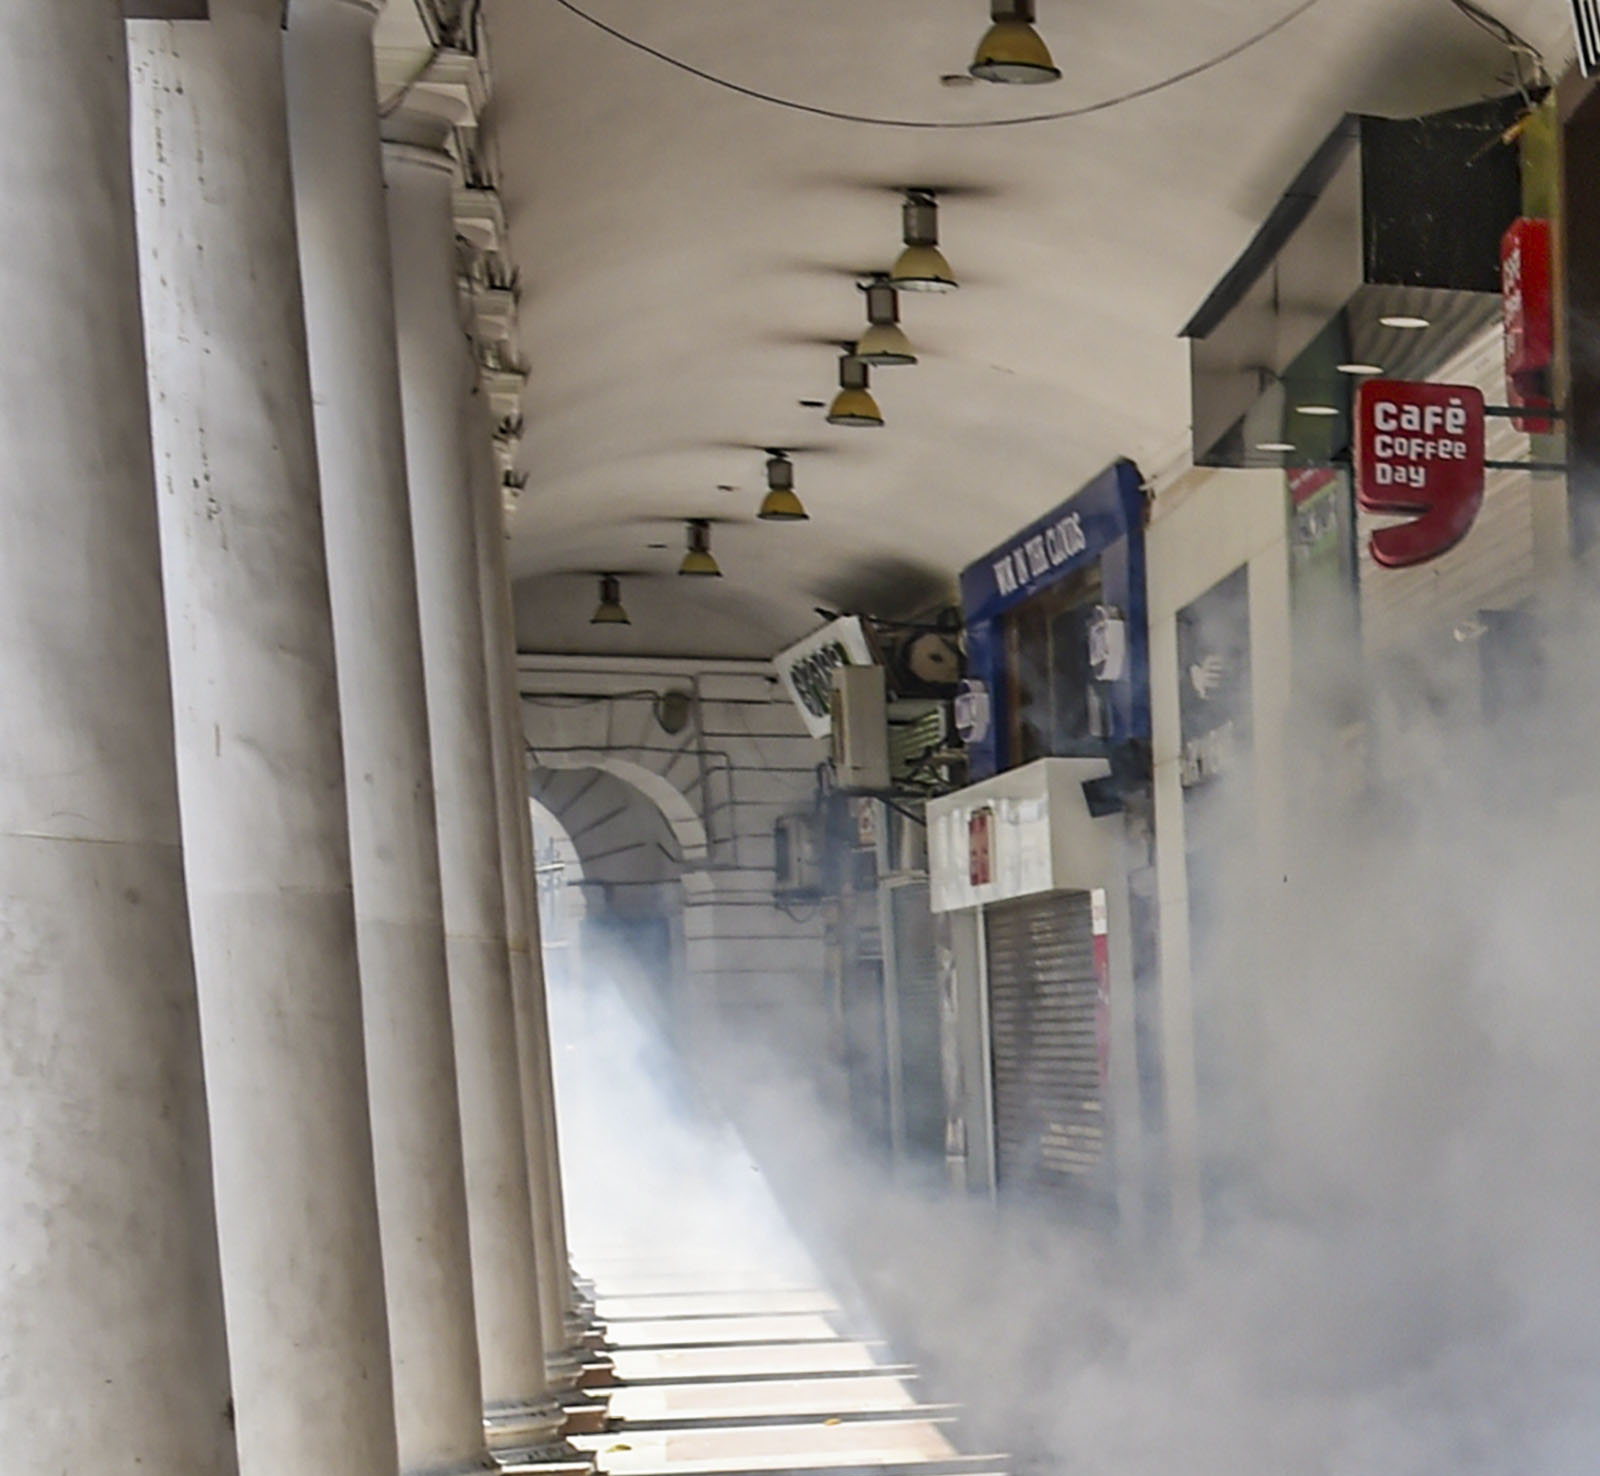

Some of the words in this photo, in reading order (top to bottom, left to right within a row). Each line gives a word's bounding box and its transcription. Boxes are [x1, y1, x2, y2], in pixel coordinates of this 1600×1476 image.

[1373, 397, 1466, 435] Café
[1374, 434, 1468, 461] Coffee
[1375, 461, 1427, 489] Day
